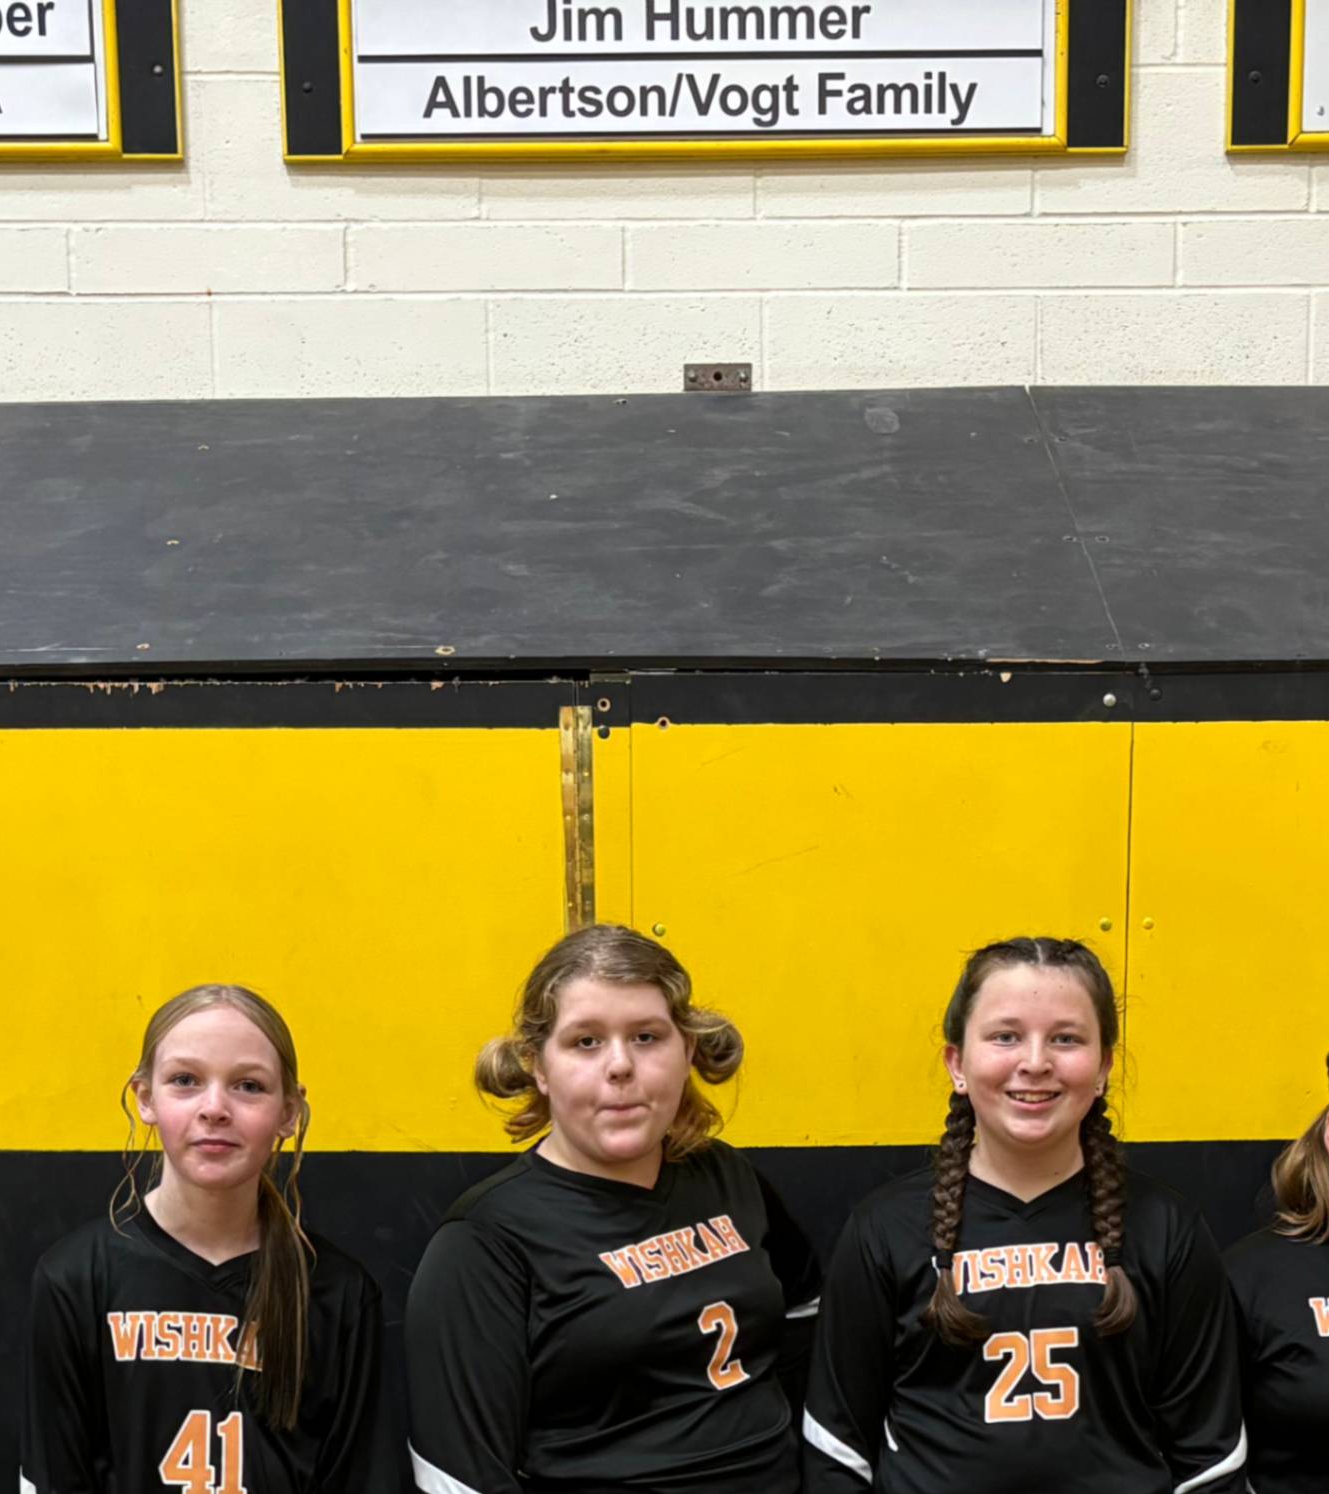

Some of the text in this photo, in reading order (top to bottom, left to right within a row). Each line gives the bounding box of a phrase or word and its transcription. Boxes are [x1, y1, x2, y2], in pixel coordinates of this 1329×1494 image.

[530, 0, 871, 42] Jim Hummer
[422, 71, 978, 127] Albertson/Vogt Family
[598, 1215, 751, 1289] WISHKAH
[107, 1311, 263, 1371] WISHKA
[698, 1301, 751, 1391] 2
[983, 1327, 1080, 1424] 25
